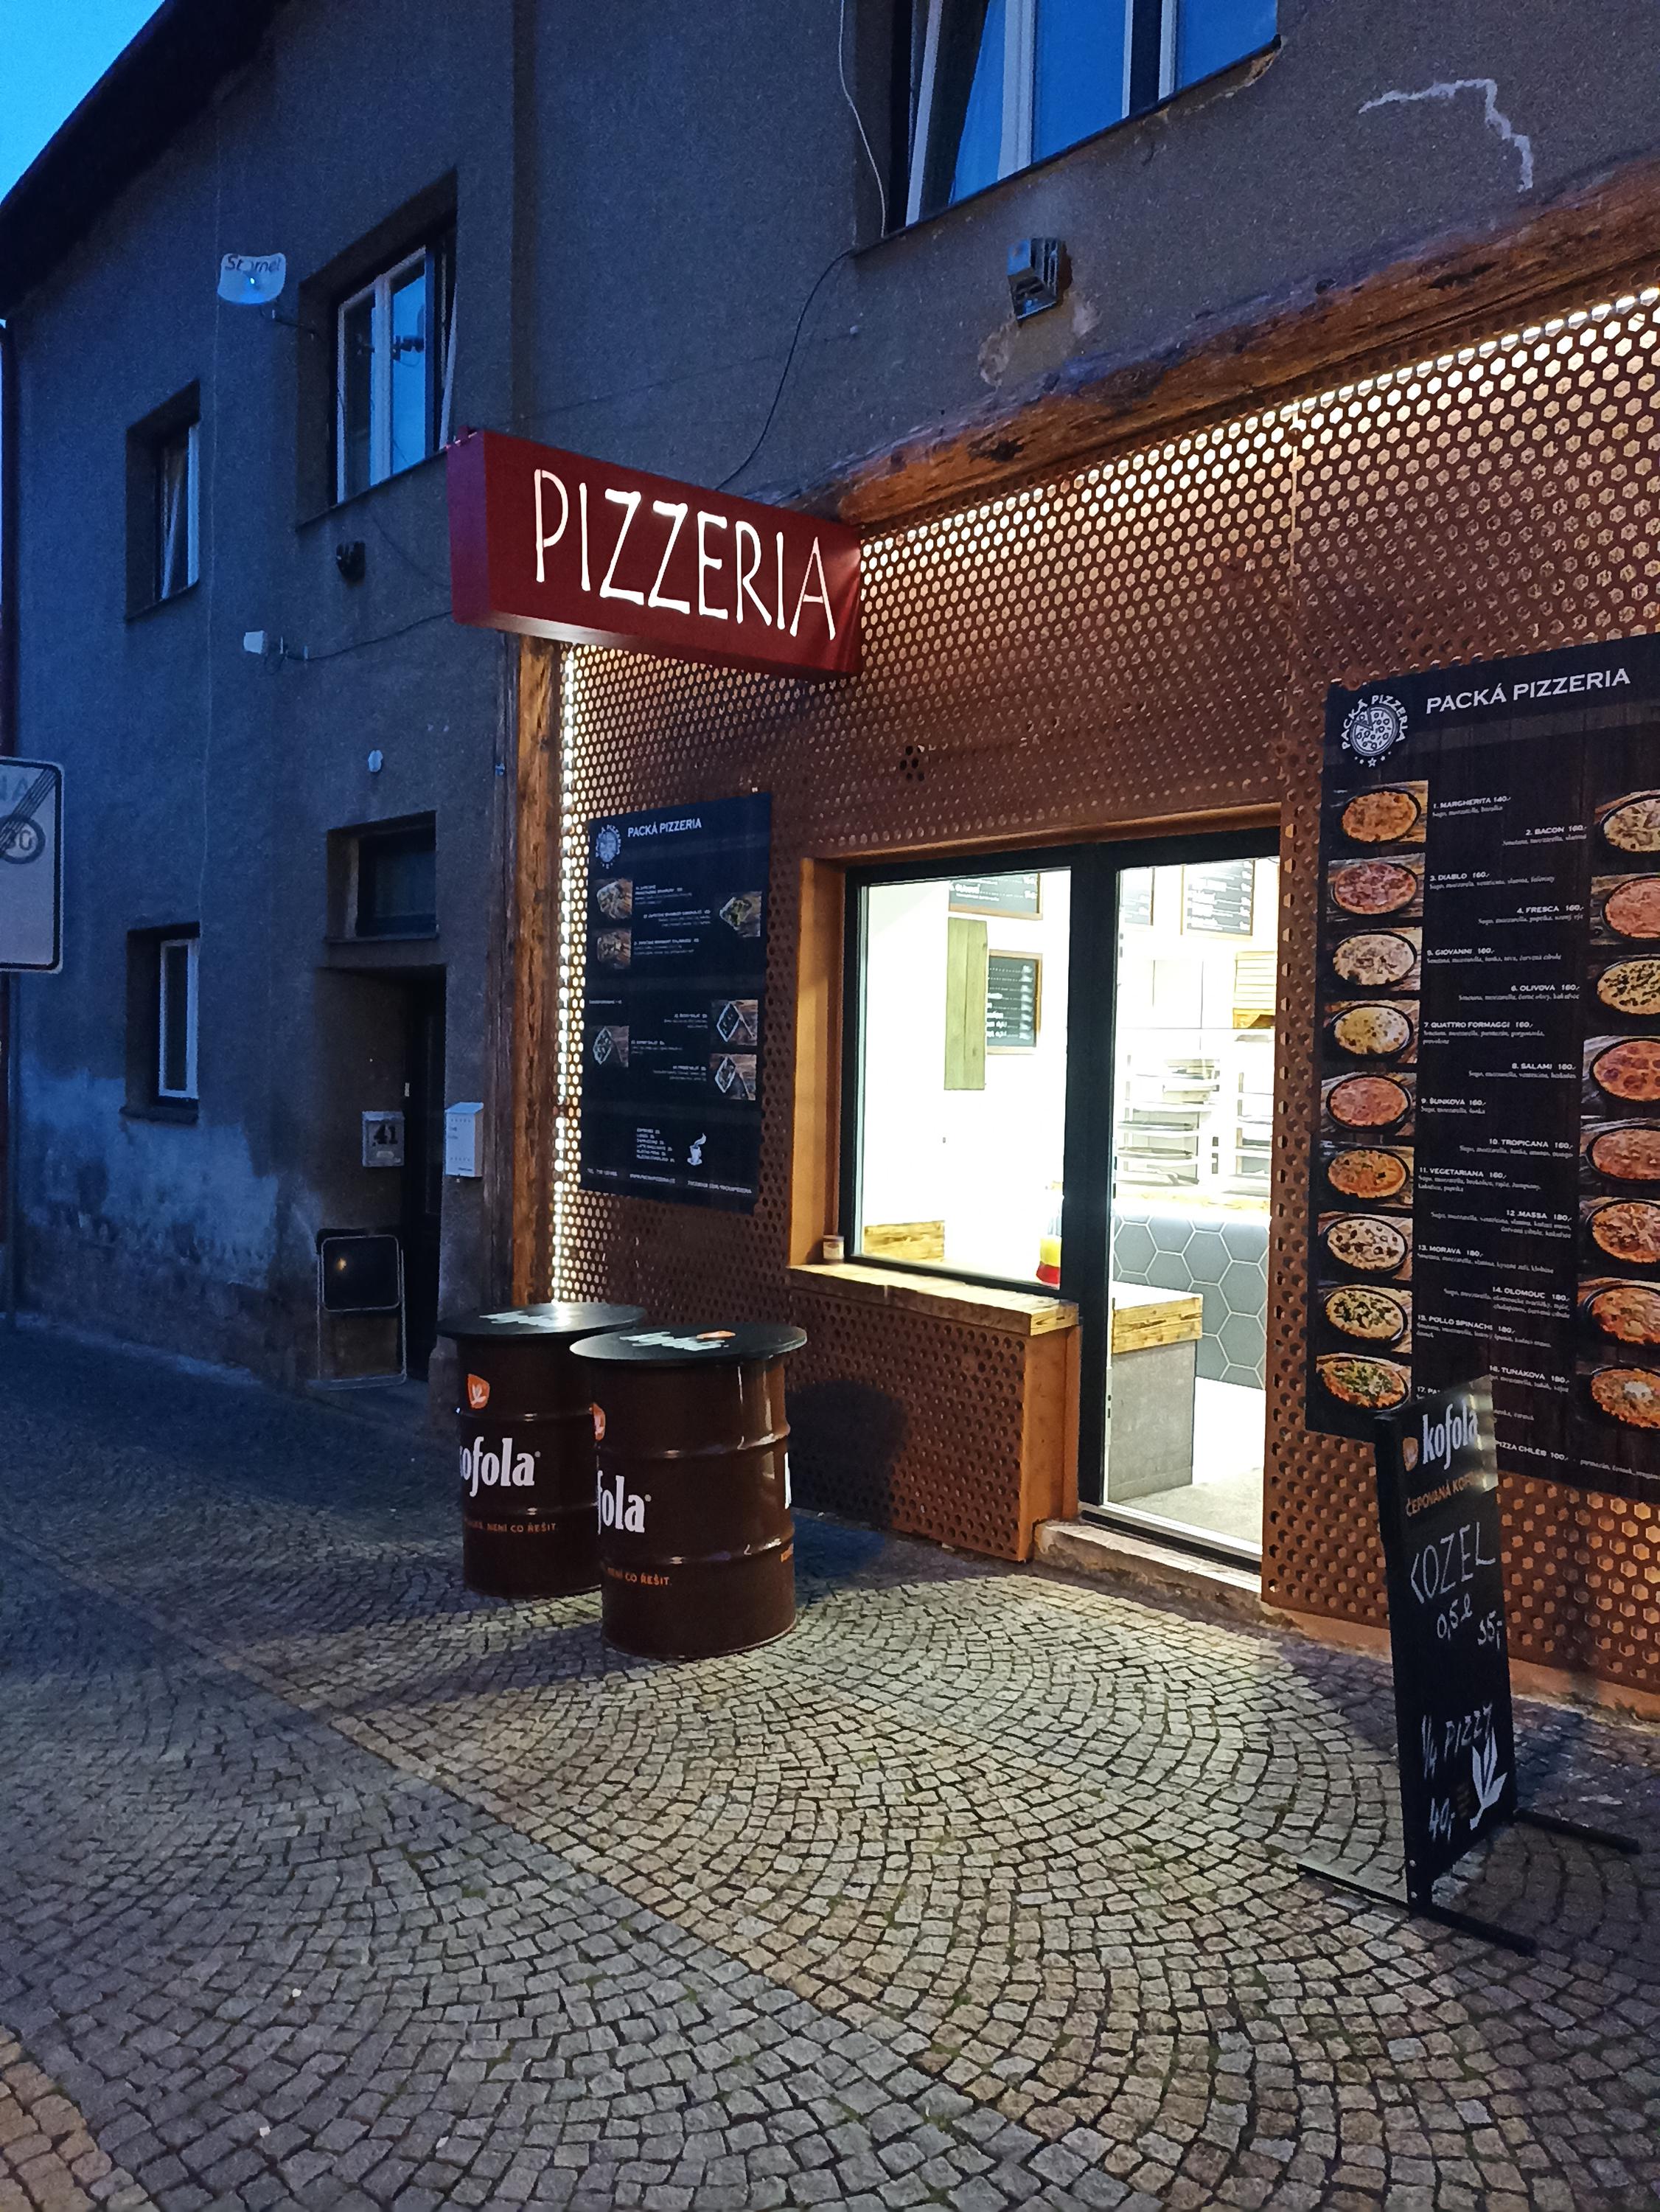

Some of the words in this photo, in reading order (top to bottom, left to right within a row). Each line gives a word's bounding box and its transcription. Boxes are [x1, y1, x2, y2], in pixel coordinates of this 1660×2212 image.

[534, 468, 836, 641] PIZZERIA
[1426, 683, 1507, 714] PACKÁ
[1513, 668, 1631, 700] PIZZERIA
[1371, 694, 1409, 742] PIZZERIA
[1440, 797, 1491, 808] MARGHERITA
[628, 821, 658, 838] PACKÁ
[660, 818, 702, 834] PIZZERIA
[1535, 826, 1565, 835] BACON
[1438, 873, 1467, 881] DIABLO
[1526, 905, 1560, 914] FRESCA
[1502, 1139, 1549, 1148] TROPICANA
[1430, 1168, 1484, 1178] VEGETARIANA
[1429, 1245, 1462, 1255] MORAVA
[1504, 1287, 1545, 1298] OLOMOUC
[1429, 1315, 1454, 1326] POLLO
[1423, 1400, 1478, 1470] kofola
[459, 1436, 535, 1498] ofola
[510, 1524, 524, 1533] CO
[625, 1571, 638, 1582] CO
